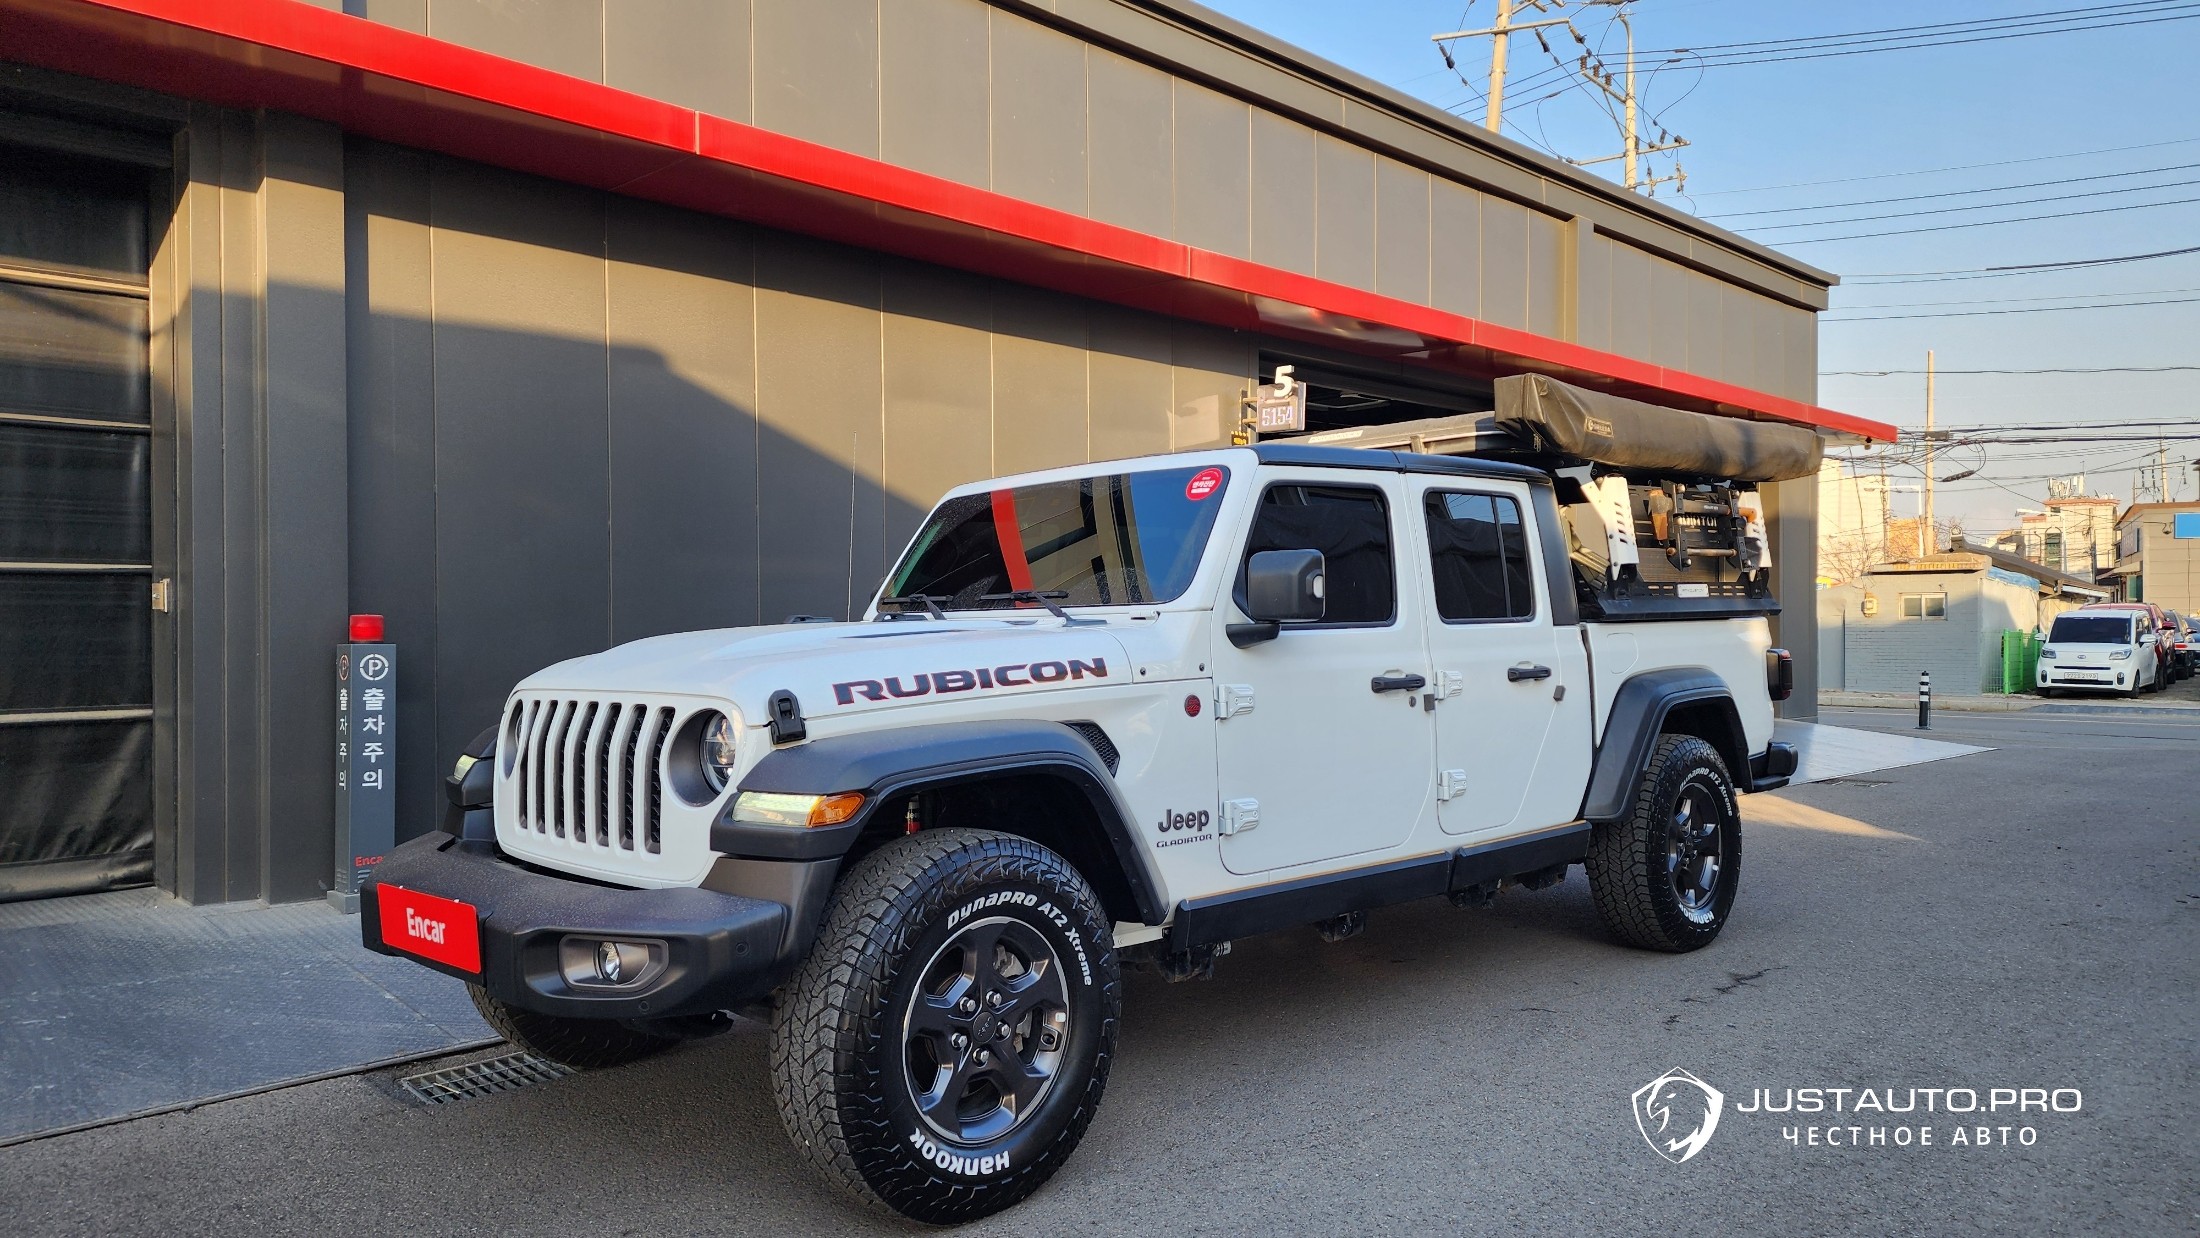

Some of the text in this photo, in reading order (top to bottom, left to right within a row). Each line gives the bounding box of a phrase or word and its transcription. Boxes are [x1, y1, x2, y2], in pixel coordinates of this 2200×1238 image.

[1273, 365, 1295, 398] 5
[1261, 406, 1294, 427] 5154
[832, 657, 1109, 706] RUBICON
[361, 687, 386, 790] 출차주의
[1157, 808, 1210, 833] Jeep
[1156, 833, 1213, 848] GLADIATOR
[354, 855, 386, 868] Enca
[405, 907, 446, 945] Encar
[1037, 901, 1068, 928] AT2
[1064, 926, 1093, 986] Xtreme
